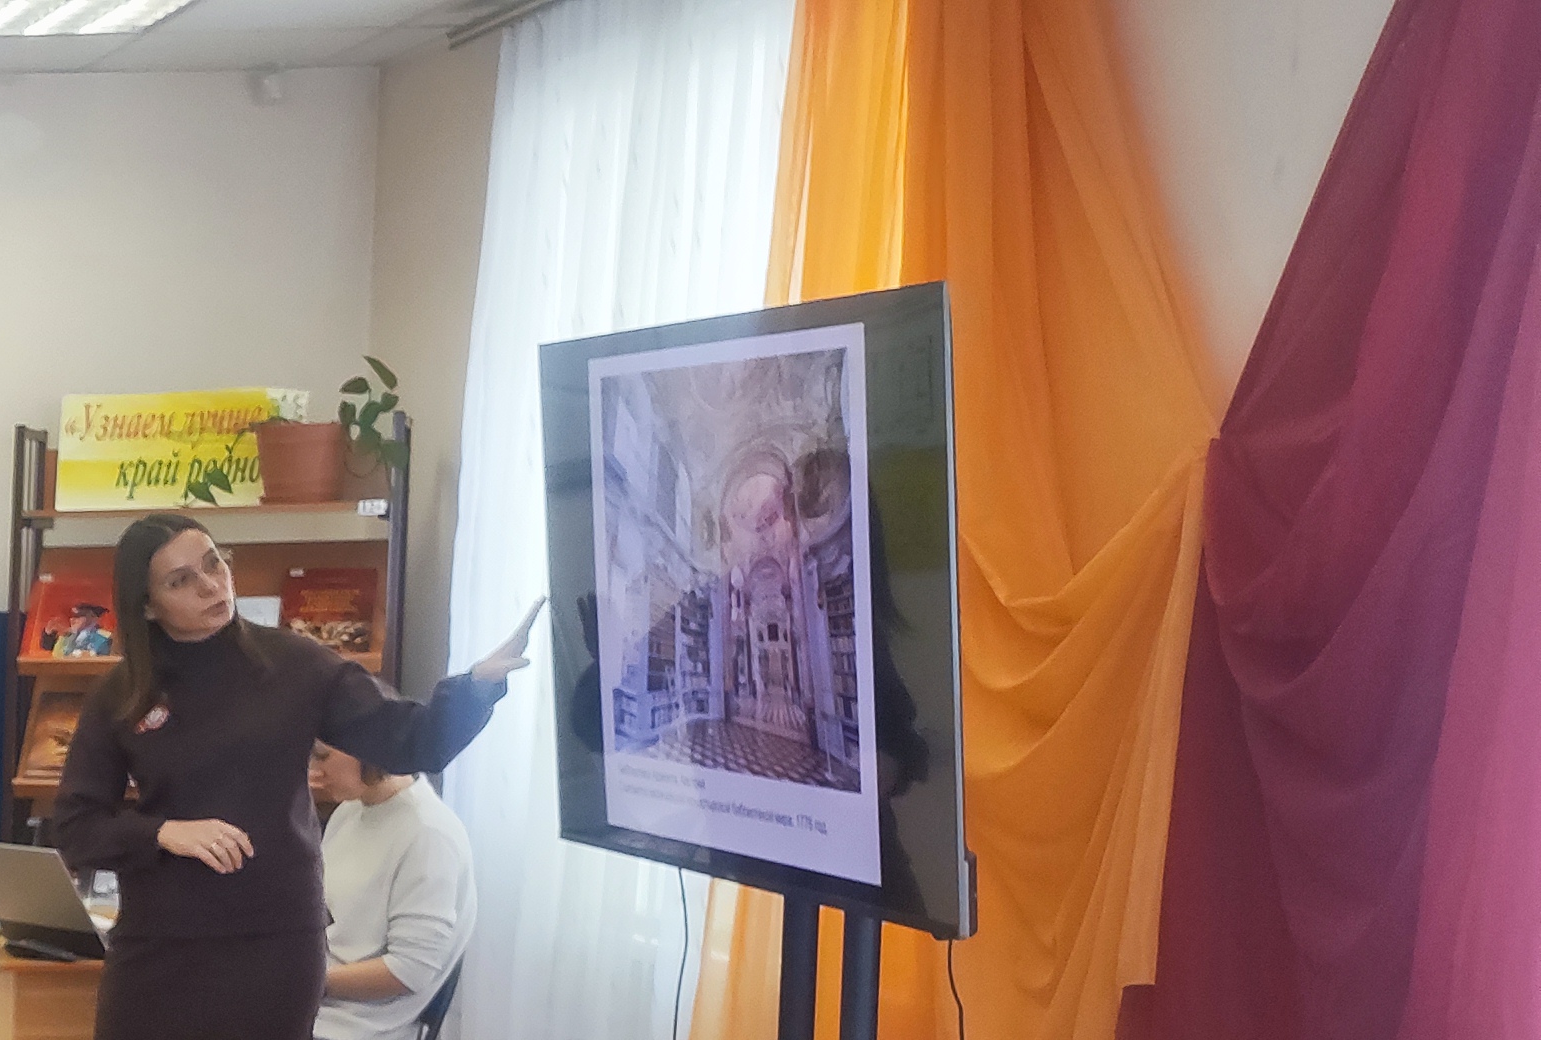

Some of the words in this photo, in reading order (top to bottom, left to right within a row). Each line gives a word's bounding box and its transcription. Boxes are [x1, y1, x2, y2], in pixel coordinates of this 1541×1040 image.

[65, 403, 175, 441] «Узнаем
[116, 450, 181, 499] край
[183, 449, 260, 500] родно
